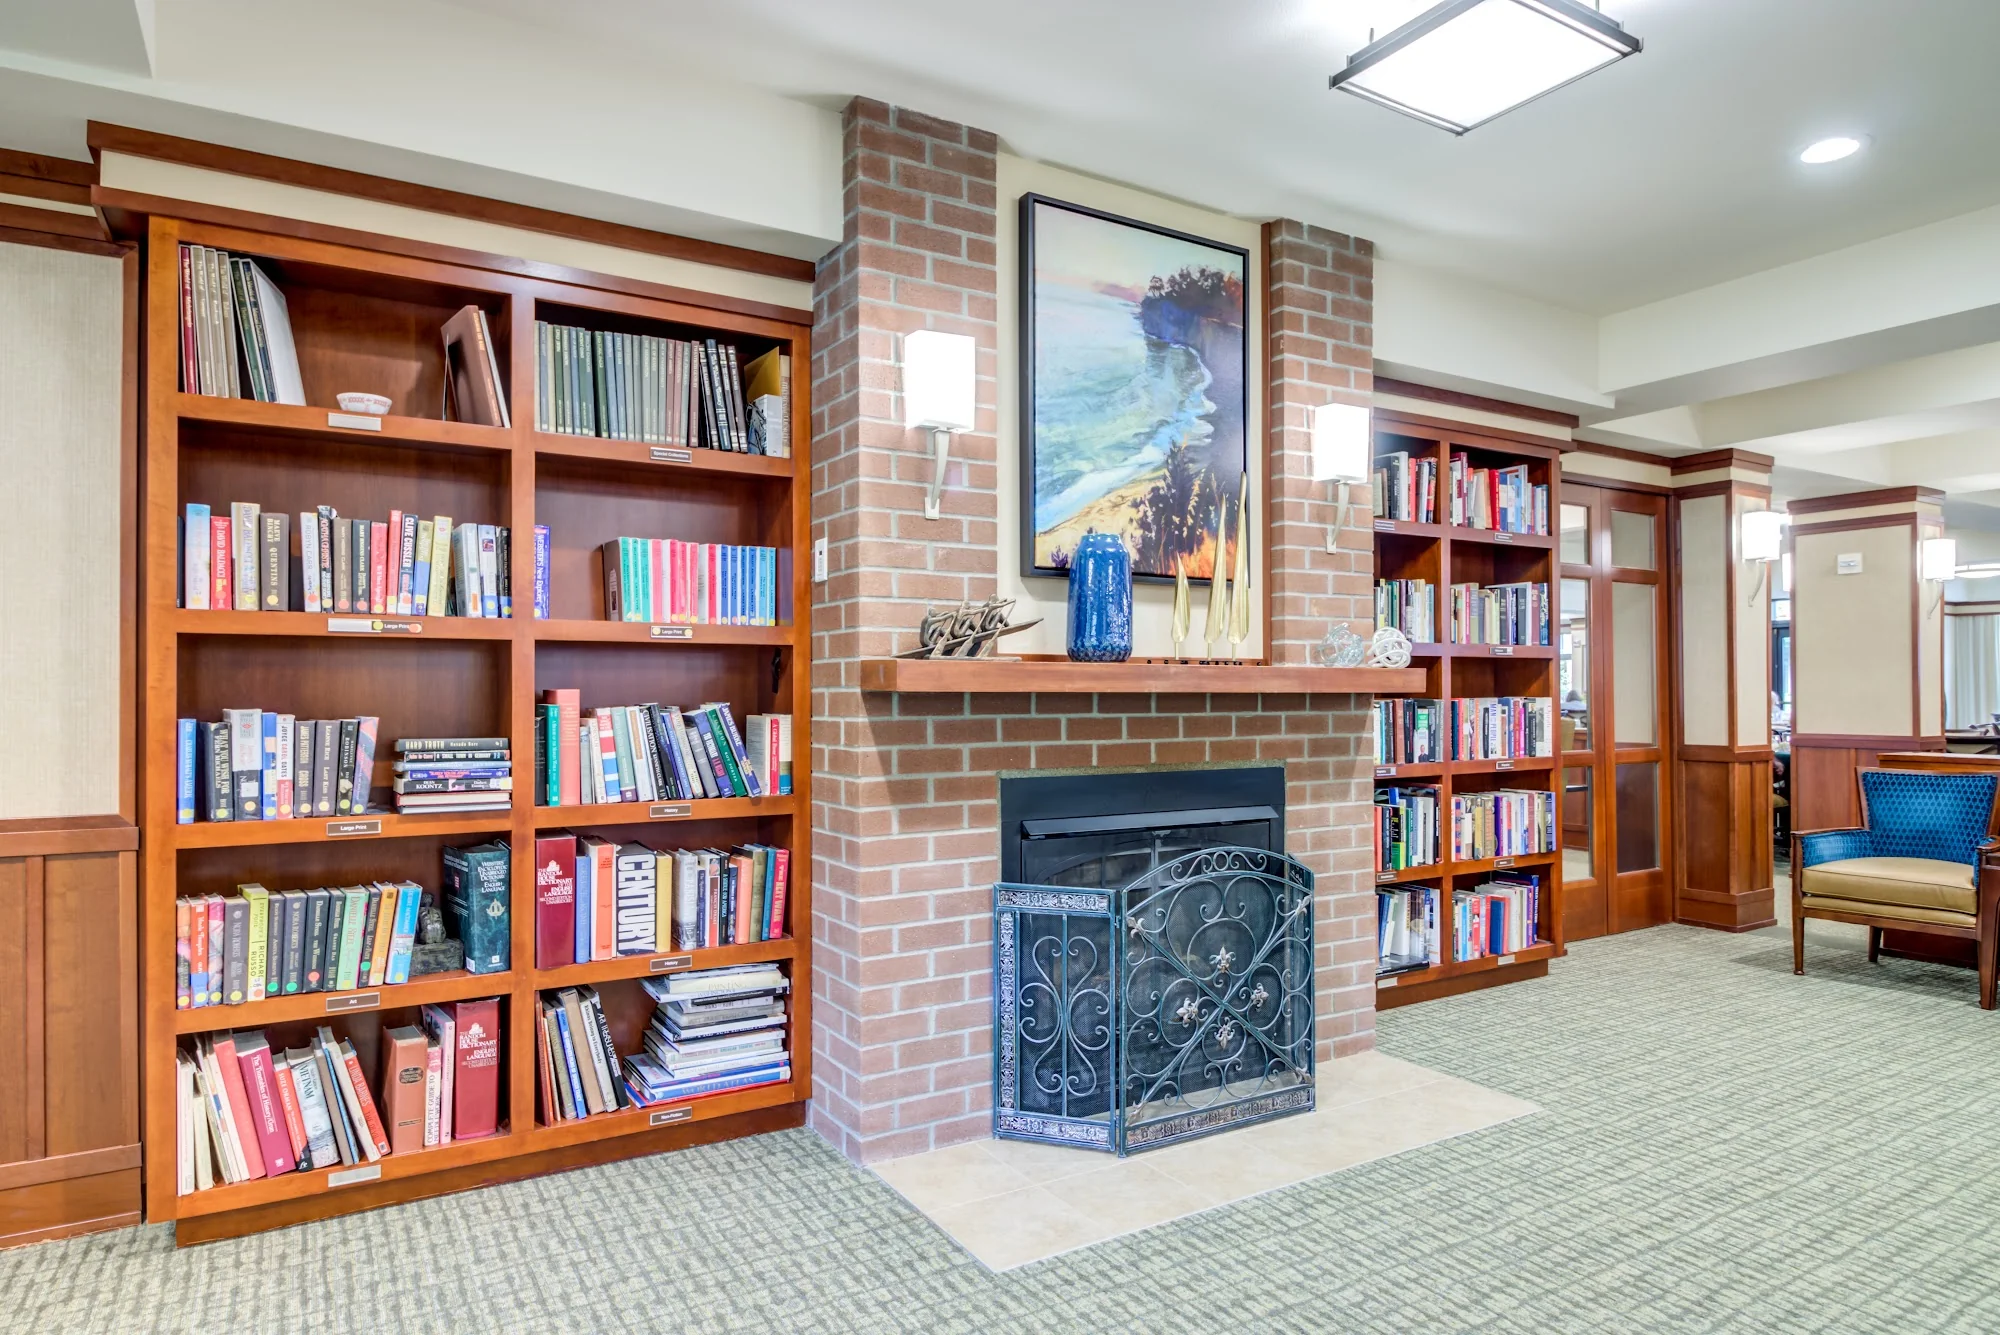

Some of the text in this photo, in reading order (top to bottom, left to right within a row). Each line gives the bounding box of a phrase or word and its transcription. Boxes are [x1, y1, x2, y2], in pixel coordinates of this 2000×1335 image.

[404, 517, 415, 537] CLIVE
[217, 530, 226, 548] DAVID
[321, 519, 329, 569] AGATHA CHRISTIE
[403, 537, 413, 568] CUSSLER
[537, 535, 545, 567] WEBSTER'S
[216, 549, 226, 578] BALDACCI
[269, 547, 278, 586] QUENTINS
[534, 580, 545, 603] Explorer
[642, 709, 657, 753] CIVILISATION
[722, 707, 742, 747] JAMES BURKE
[298, 725, 310, 787] JAMES PATTERSON CROSS
[405, 740, 422, 750] HARD
[424, 740, 445, 749] TRUTH
[712, 714, 727, 746] LONDON
[728, 763, 738, 782] PORTER
[219, 728, 230, 794] WHAT YOU WISH FOR
[478, 864, 508, 872] ENCYCLOPEDIC
[537, 877, 574, 886] DICTIONARY
[774, 881, 784, 899] NEXT
[315, 900, 324, 922] DANIELLE
[334, 901, 342, 917] DANIELLE
[369, 897, 379, 918] DANIELLE
[617, 854, 656, 951] CENTURY
[773, 900, 784, 922] WAR
[233, 922, 242, 937] NORA
[346, 896, 360, 945] DANIELLE STEEL
[367, 918, 377, 932] STEEL
[403, 907, 412, 933] MACOMBER
[291, 926, 299, 949] ROBERTS
[311, 948, 320, 970] WEDDING
[459, 1039, 498, 1050] DICTIONARY
[592, 1041, 602, 1064] Everybody
[253, 1055, 262, 1065] The
[466, 1053, 497, 1061] LANGUAGE
[255, 1066, 266, 1094] Timetables
[299, 1064, 315, 1099] VIETNAM
[348, 1065, 362, 1083] LINDA
[355, 1082, 371, 1107] BARNES
[428, 1074, 435, 1084] TO
[681, 1077, 755, 1094] WORLD ATLAS
[278, 1072, 292, 1111] SUZE ORMAN
